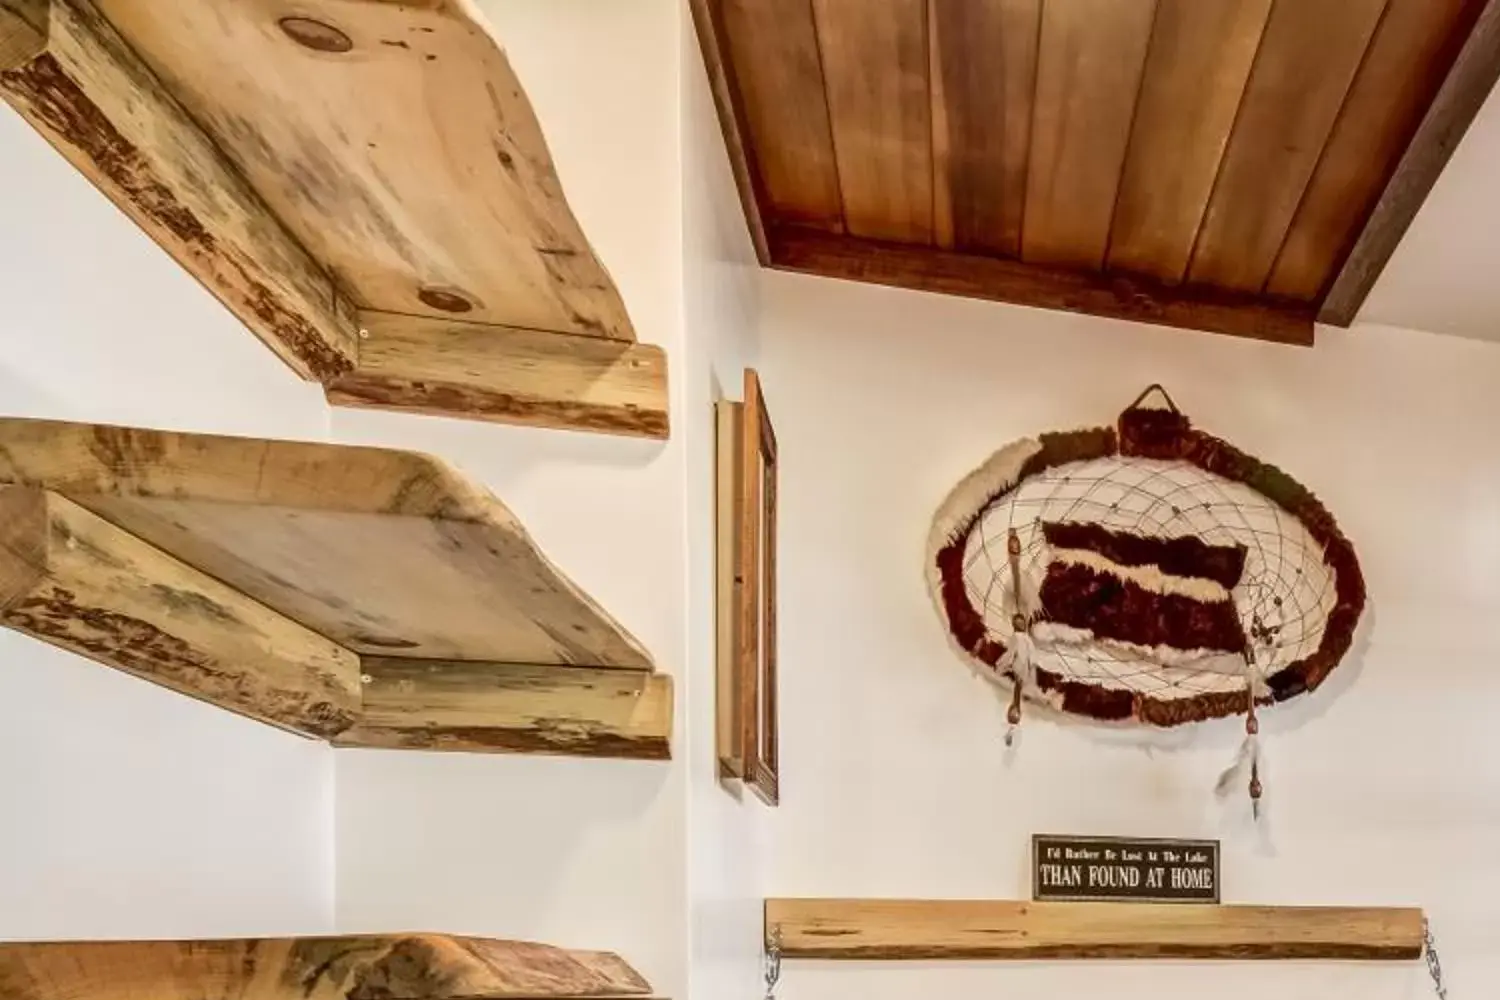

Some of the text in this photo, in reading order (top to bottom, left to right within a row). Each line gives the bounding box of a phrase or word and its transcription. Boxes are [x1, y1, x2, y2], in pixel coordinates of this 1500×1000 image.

[1065, 848, 1100, 860] Rather
[1040, 864, 1212, 889] THAN FOUND AT HOME
